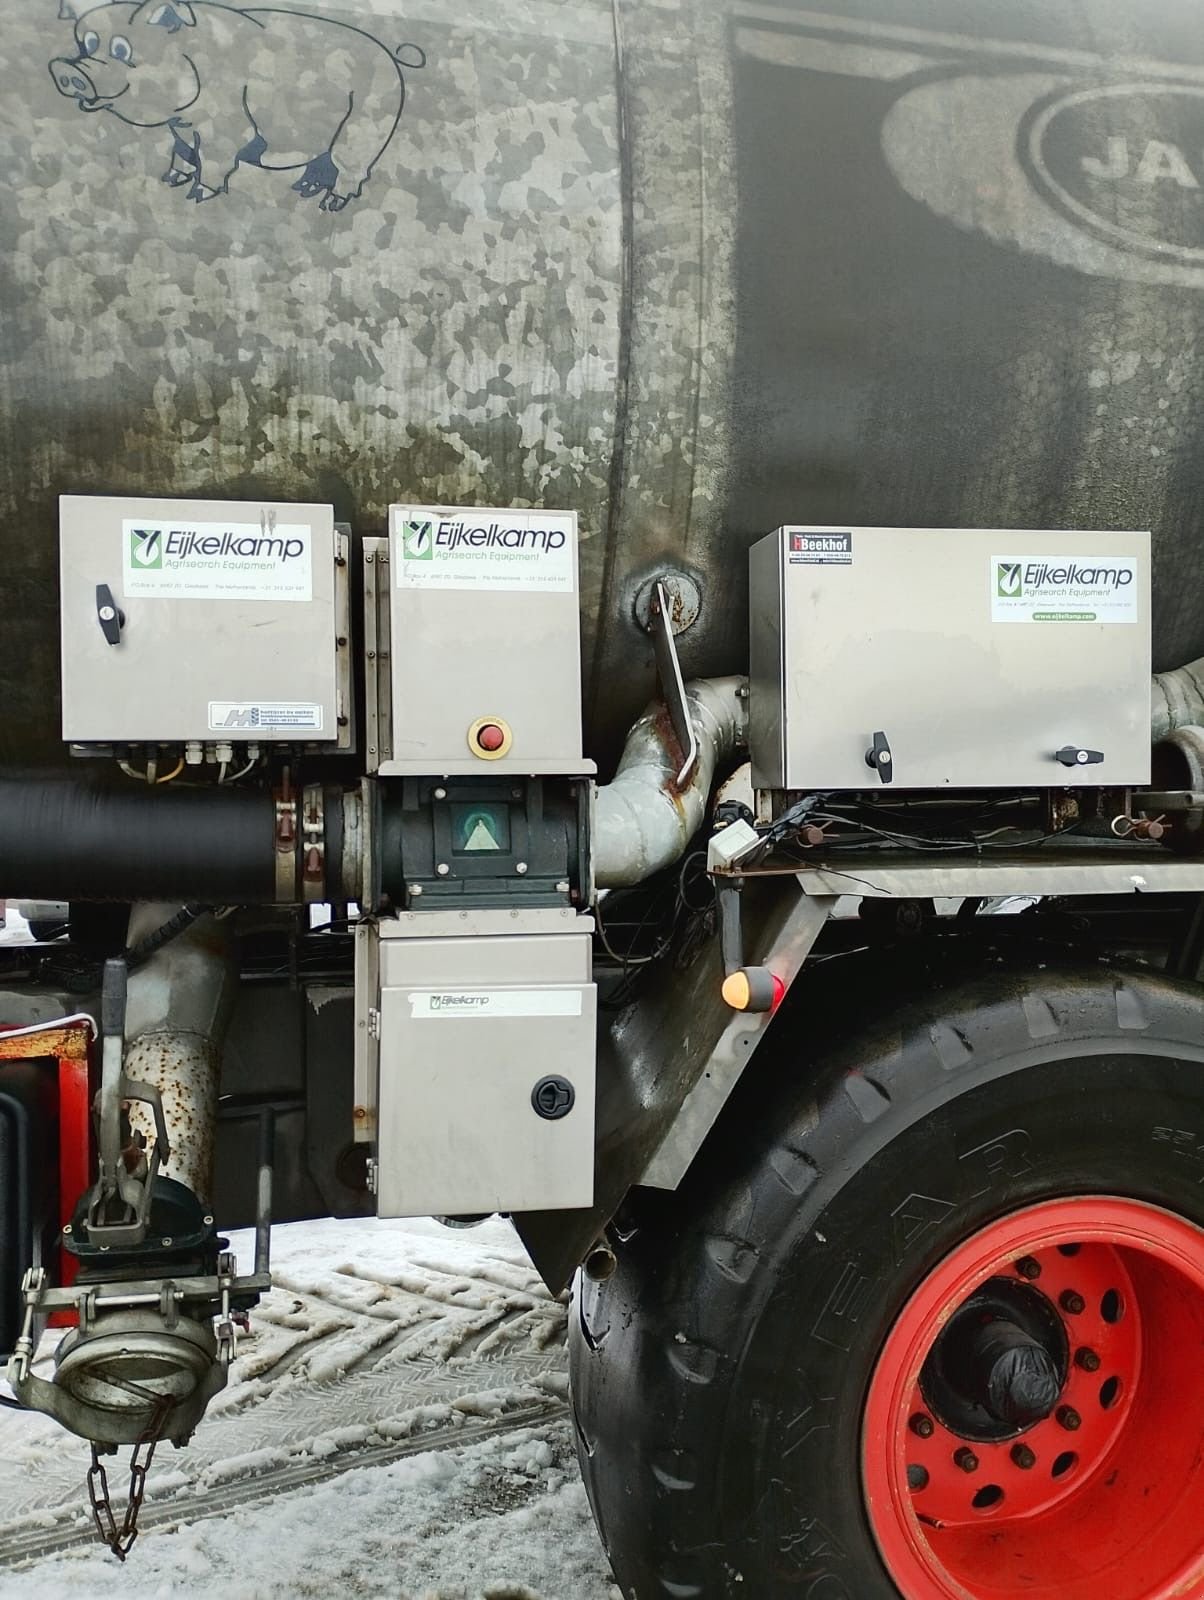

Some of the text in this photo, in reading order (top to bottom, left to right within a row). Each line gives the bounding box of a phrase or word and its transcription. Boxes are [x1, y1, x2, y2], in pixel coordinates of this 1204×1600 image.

[1079, 135, 1204, 189] JA
[165, 530, 304, 562] Eijkelkamp
[435, 522, 566, 554] Eijkelkamp
[165, 558, 276, 571] Agrisearch Equipment
[489, 551, 540, 562] Equipment
[1024, 563, 1133, 589] Eijkelkamp
[1023, 588, 1111, 598] Agrisearch Equipment
